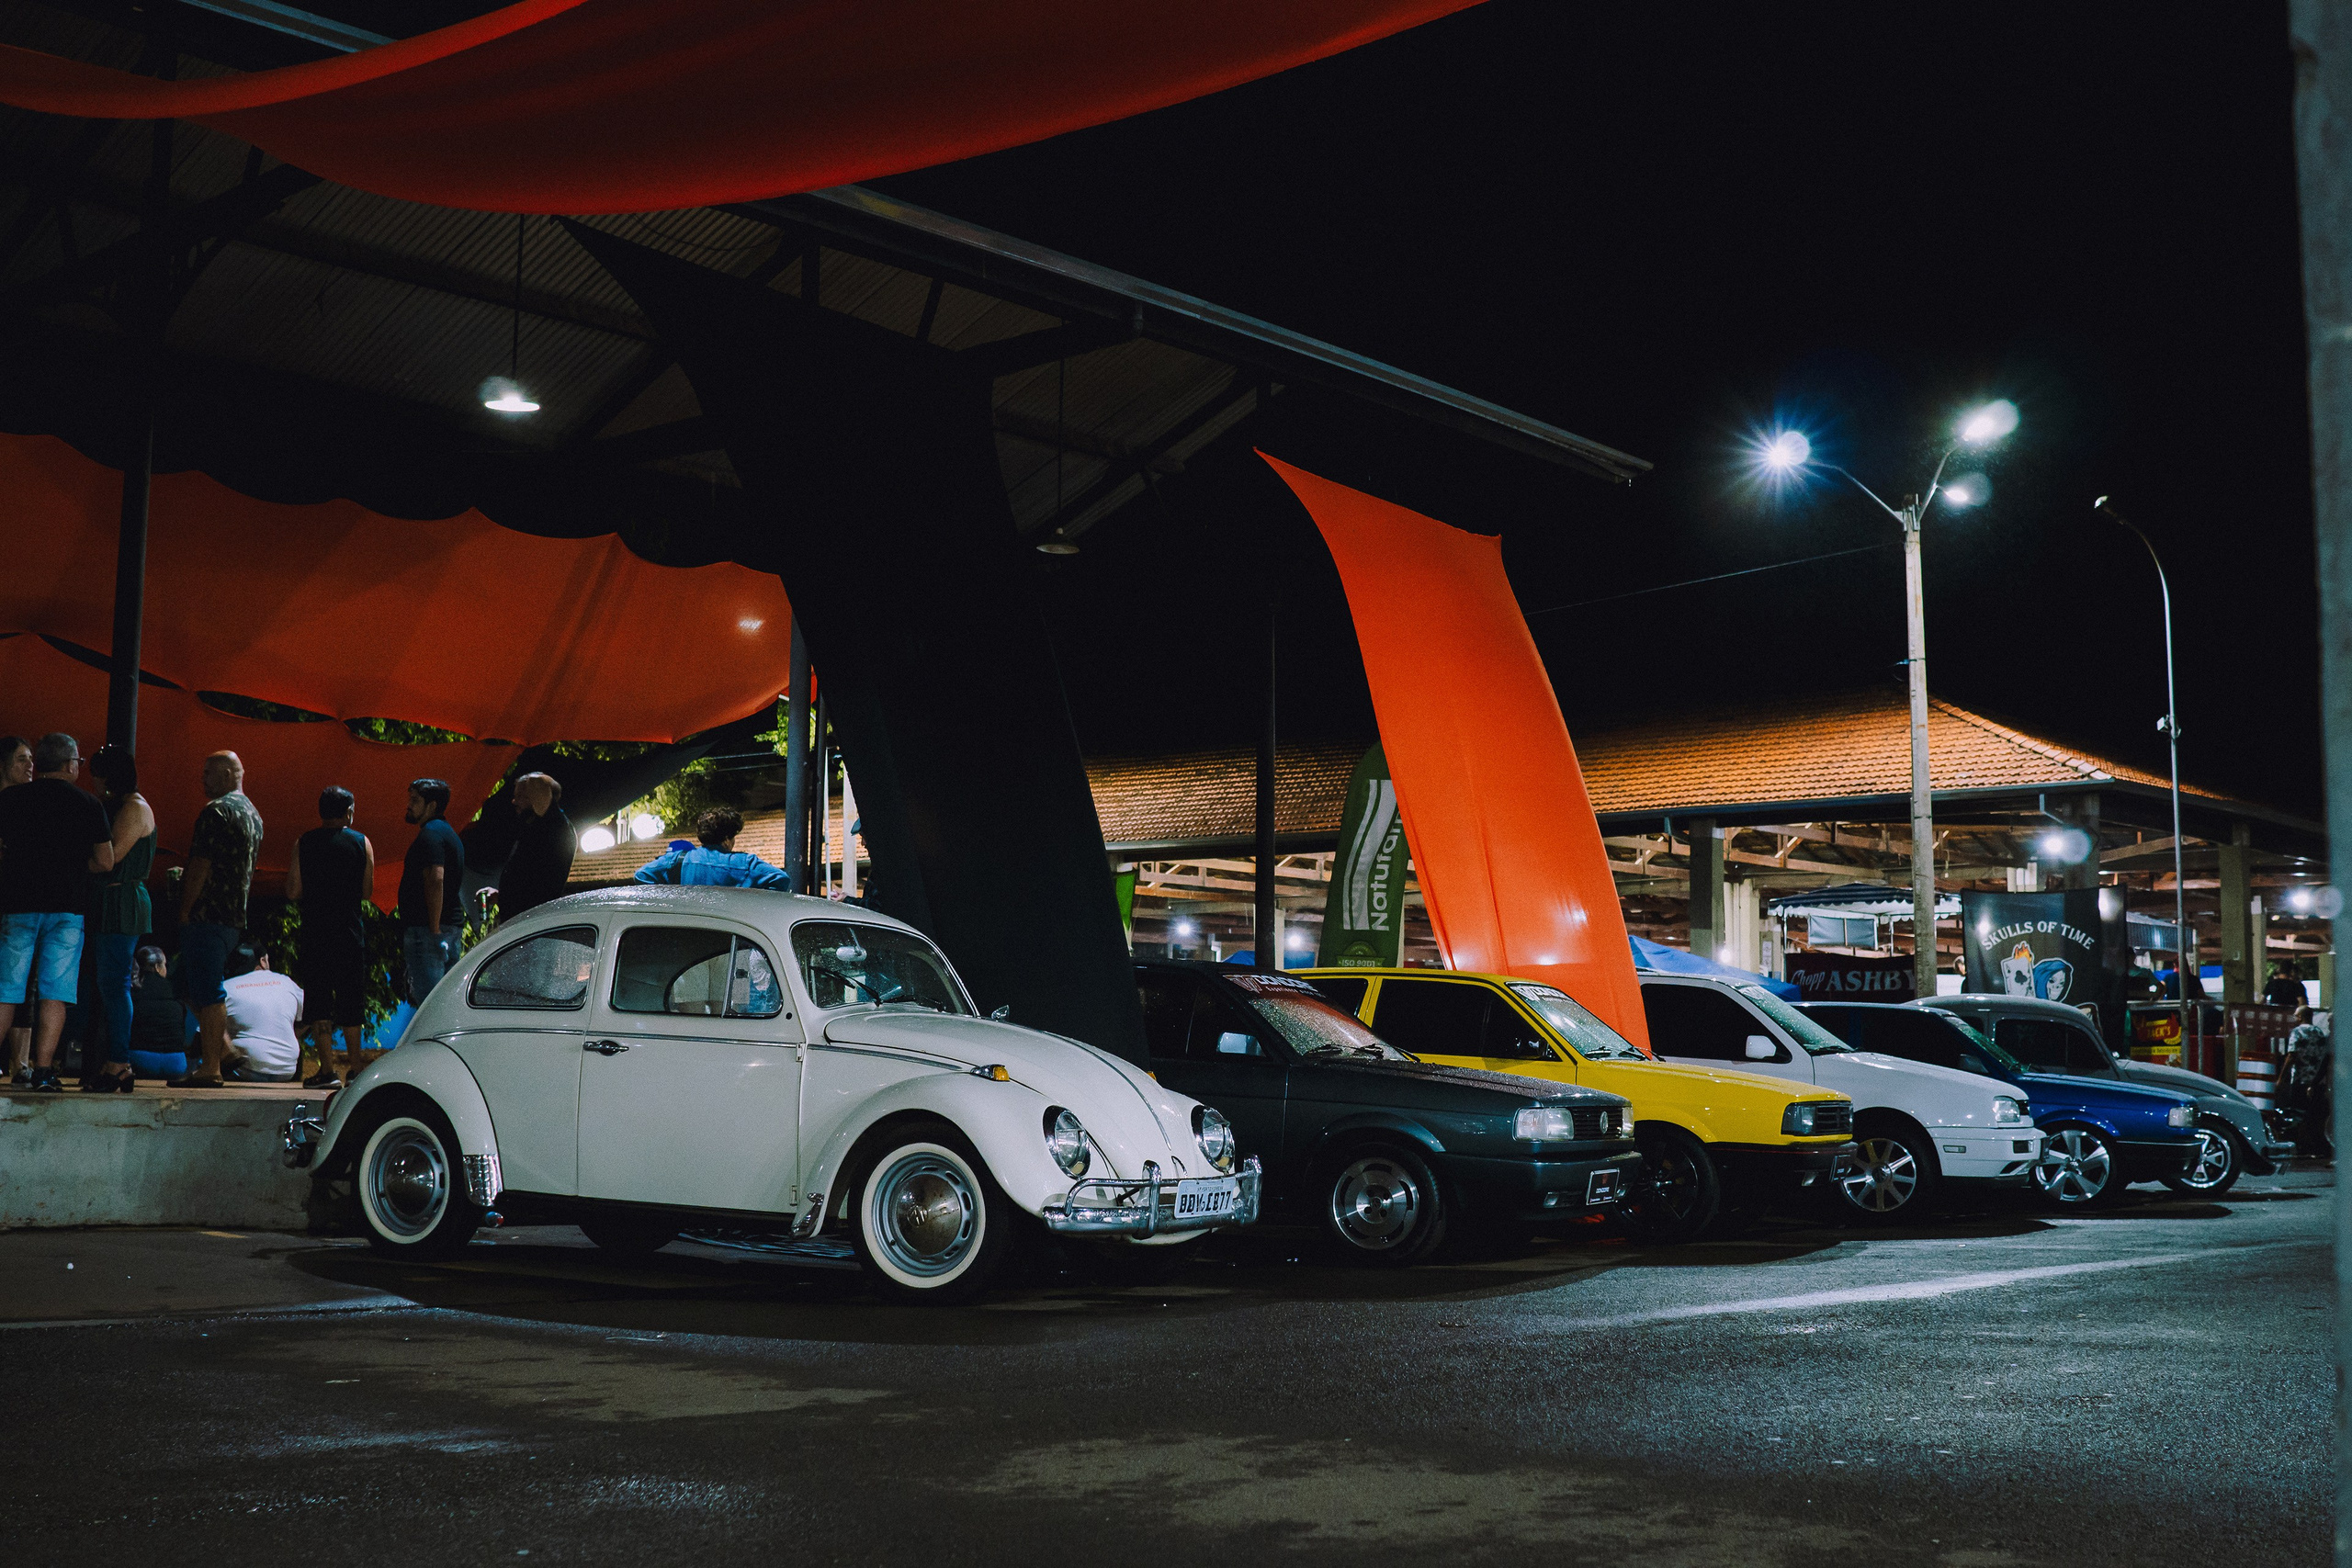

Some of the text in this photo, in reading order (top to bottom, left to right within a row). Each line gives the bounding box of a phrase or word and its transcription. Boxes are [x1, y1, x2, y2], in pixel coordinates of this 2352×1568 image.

[1981, 920, 2095, 951] SKULLS OF TIME
[1341, 959, 1355, 967] ISO
[1792, 969, 1826, 992] Chopp
